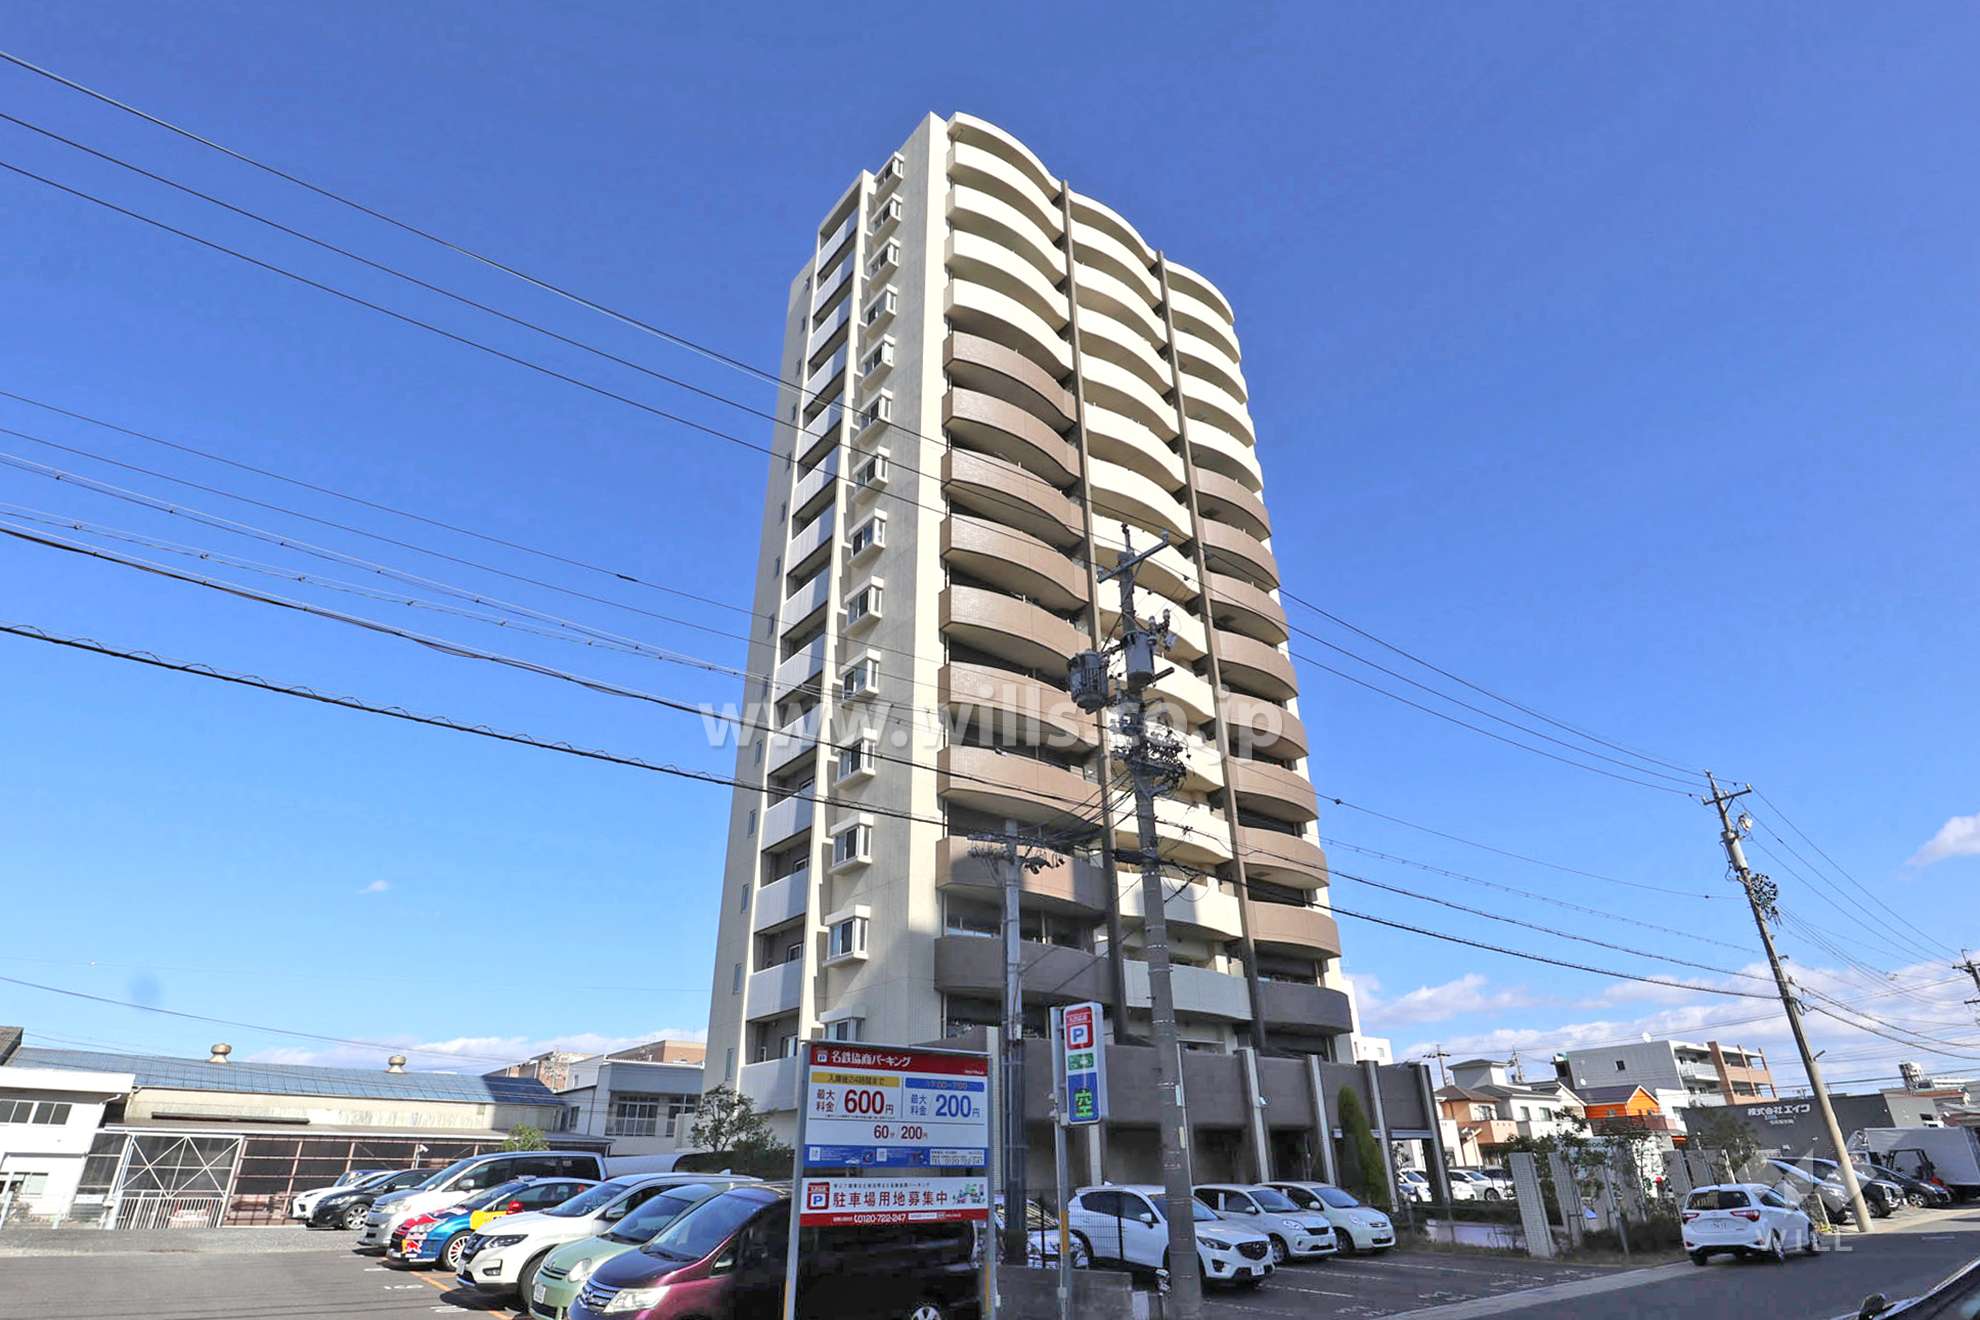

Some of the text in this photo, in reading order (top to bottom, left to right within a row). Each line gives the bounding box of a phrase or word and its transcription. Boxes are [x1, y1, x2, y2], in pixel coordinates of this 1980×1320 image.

[1073, 1028, 1084, 1042] P
[831, 1050, 912, 1067] 名鉄協商パーキング
[816, 1089, 835, 1101] 最大
[910, 1094, 928, 1105] 最大
[816, 1101, 835, 1113] 料金
[1075, 1090, 1093, 1118] 空
[910, 1105, 928, 1117] 料金
[813, 1195, 823, 1205] P
[832, 1190, 949, 1208] 駐車場用地募集中
[858, 1213, 907, 1224] 0120-722-247
